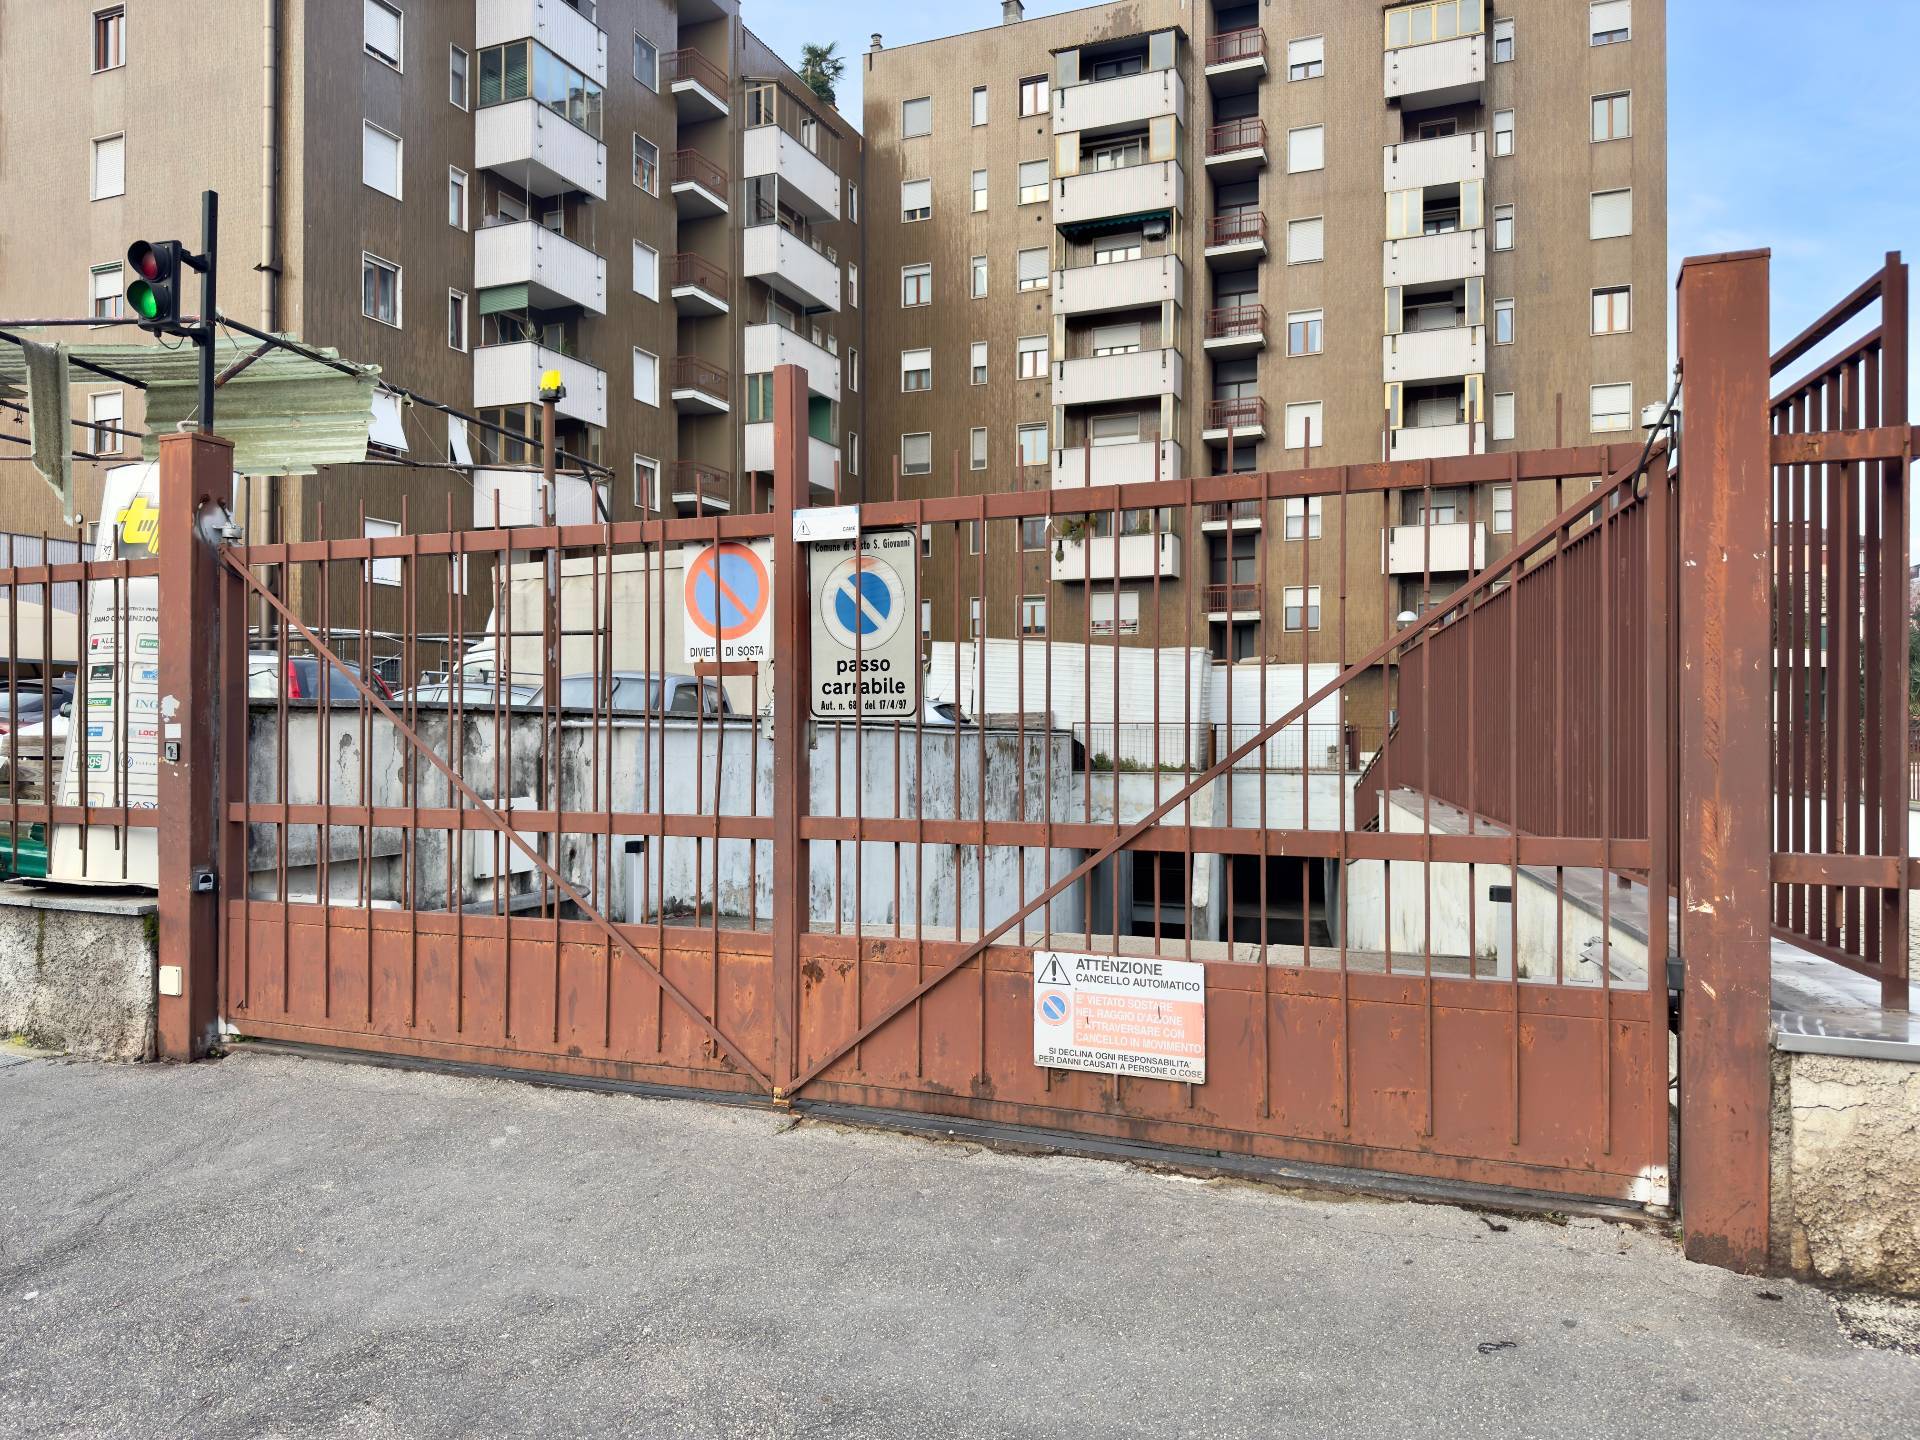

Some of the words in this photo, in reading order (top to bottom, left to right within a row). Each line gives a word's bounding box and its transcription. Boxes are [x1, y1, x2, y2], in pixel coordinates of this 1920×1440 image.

[815, 542, 840, 552] Comune
[843, 541, 850, 551] di
[852, 540, 870, 550] Ssto
[873, 539, 880, 549] S.
[883, 537, 910, 549] Giovanni
[690, 647, 718, 657] DIVIET
[725, 646, 734, 657] DI
[737, 645, 764, 656] SOSTA
[837, 658, 891, 675] passo
[821, 700, 836, 711] Aut.
[838, 703, 845, 711] n.
[864, 700, 876, 710] del
[879, 699, 907, 710] 17/4/97
[1076, 958, 1163, 976] ATTENZIONE
[1076, 973, 1130, 986] CANCELLO
[1133, 979, 1200, 992] AUTOMATICO
[1087, 995, 1125, 1008] VIETATO
[1127, 999, 1173, 1012] SOSTARE
[1075, 1007, 1095, 1017] NEL
[1097, 1009, 1134, 1021] RAGGIO
[1137, 1013, 1183, 1026] D'AZIONE
[1084, 1020, 1160, 1036] ATTRAVERSARE
[1162, 1028, 1185, 1039] CON
[1075, 1032, 1128, 1045] CANCELLO
[1130, 1038, 1140, 1048] IN
[1142, 1039, 1201, 1054] MOVIMENTO
[1049, 1047, 1057, 1055] SI
[1058, 1048, 1093, 1058] DECLINA
[1095, 1051, 1116, 1061] OGNI
[1038, 1054, 1055, 1063] PER
[1057, 1056, 1081, 1065] DANNI
[1083, 1059, 1118, 1070] CAUSATI
[1127, 1064, 1168, 1076] PERSONE
[1170, 1068, 1177, 1076] O
[1179, 1069, 1202, 1079] COSE
